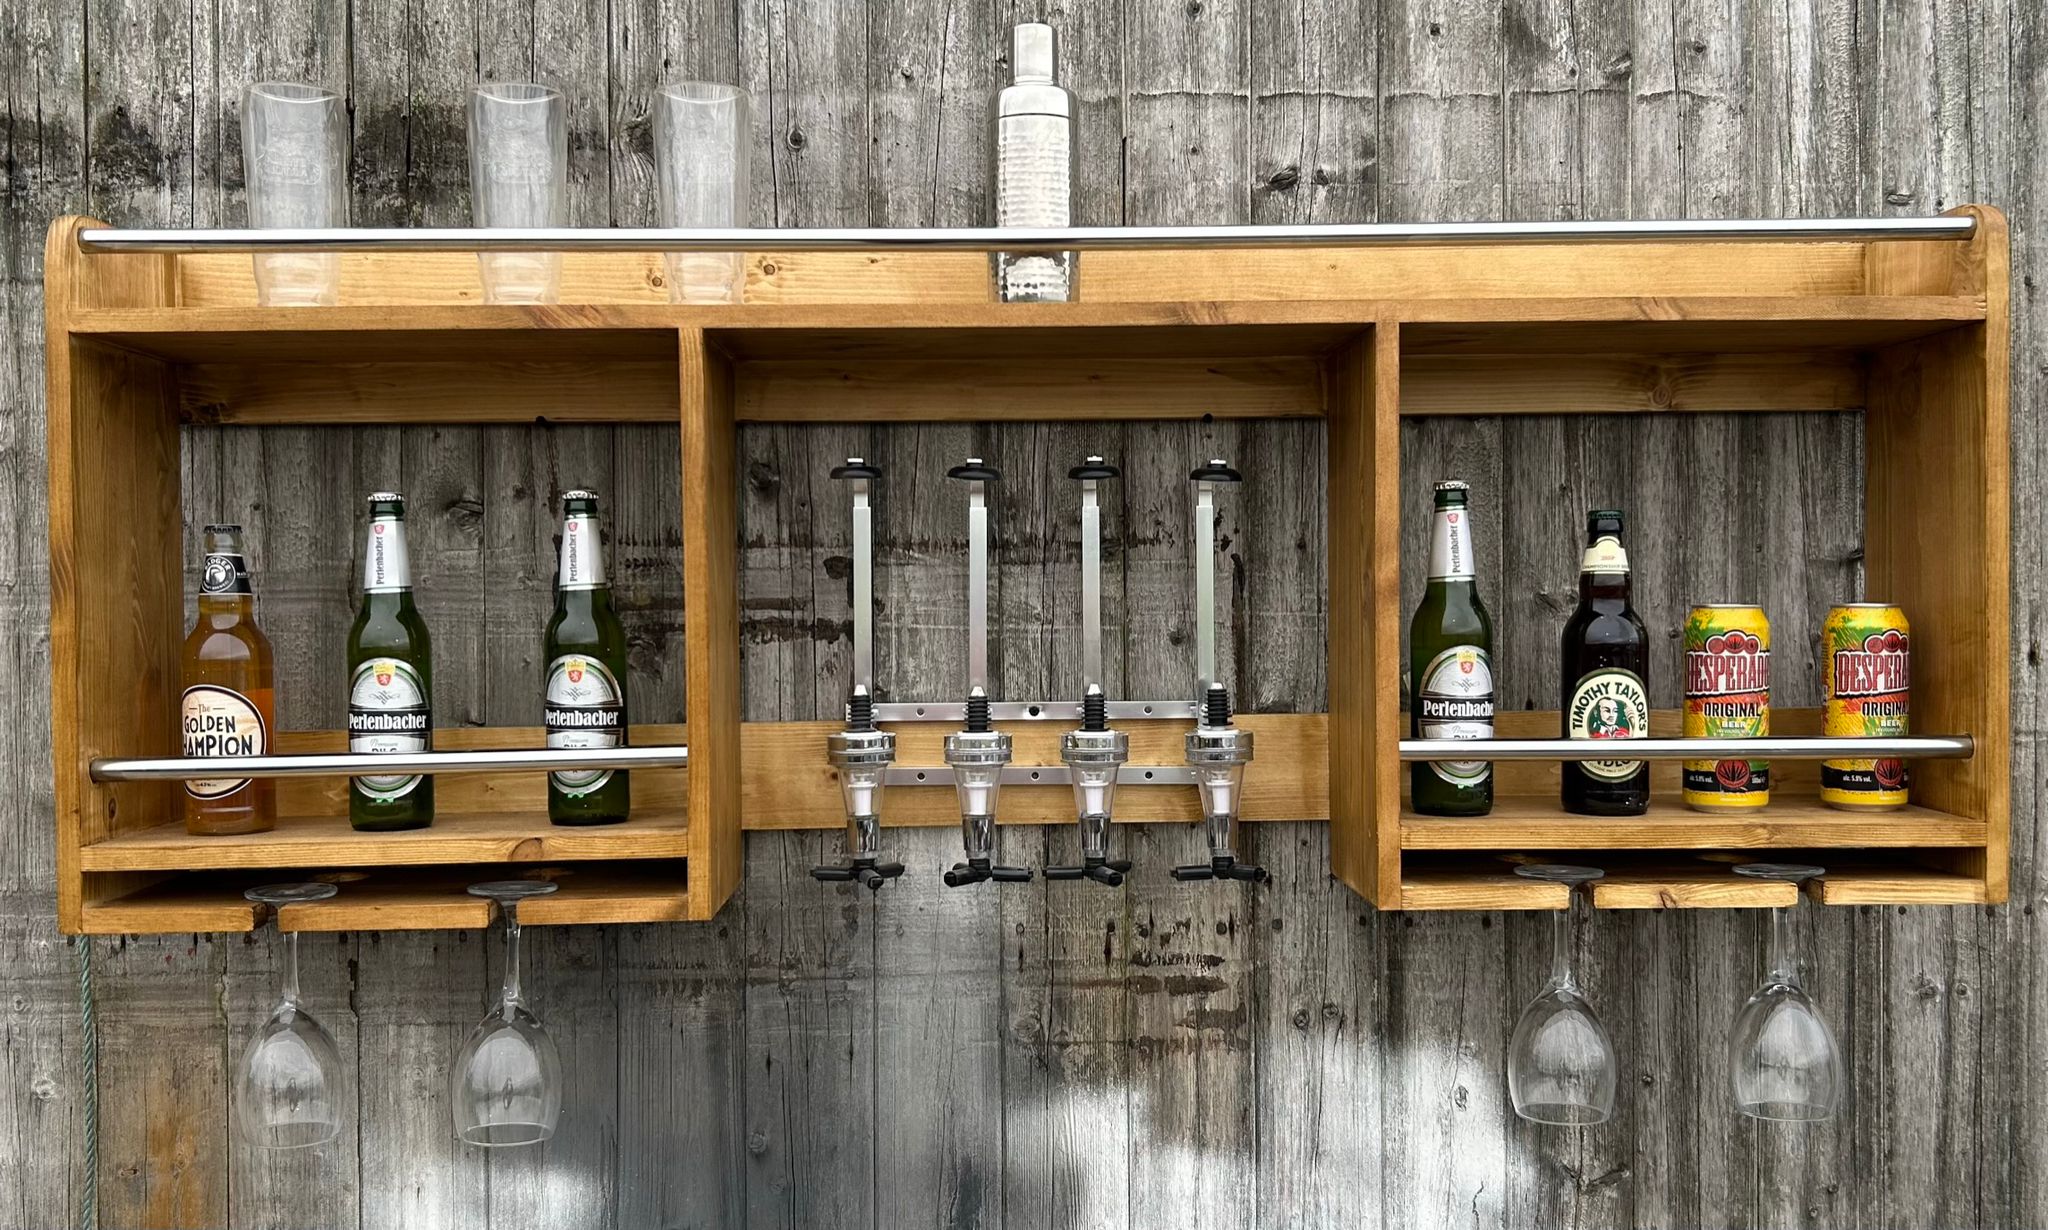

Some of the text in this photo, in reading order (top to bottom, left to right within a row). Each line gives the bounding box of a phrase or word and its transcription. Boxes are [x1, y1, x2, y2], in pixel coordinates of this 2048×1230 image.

[198, 703, 211, 713] The
[1572, 681, 1646, 731] TIMOTHY TAYLOR'S
[1704, 702, 1761, 717] ORIGINAL
[184, 714, 236, 734] GOLDEN
[349, 712, 427, 731] Perlenbacher
[545, 708, 619, 727] Perlenbacher
[1721, 720, 1746, 728] BEER
